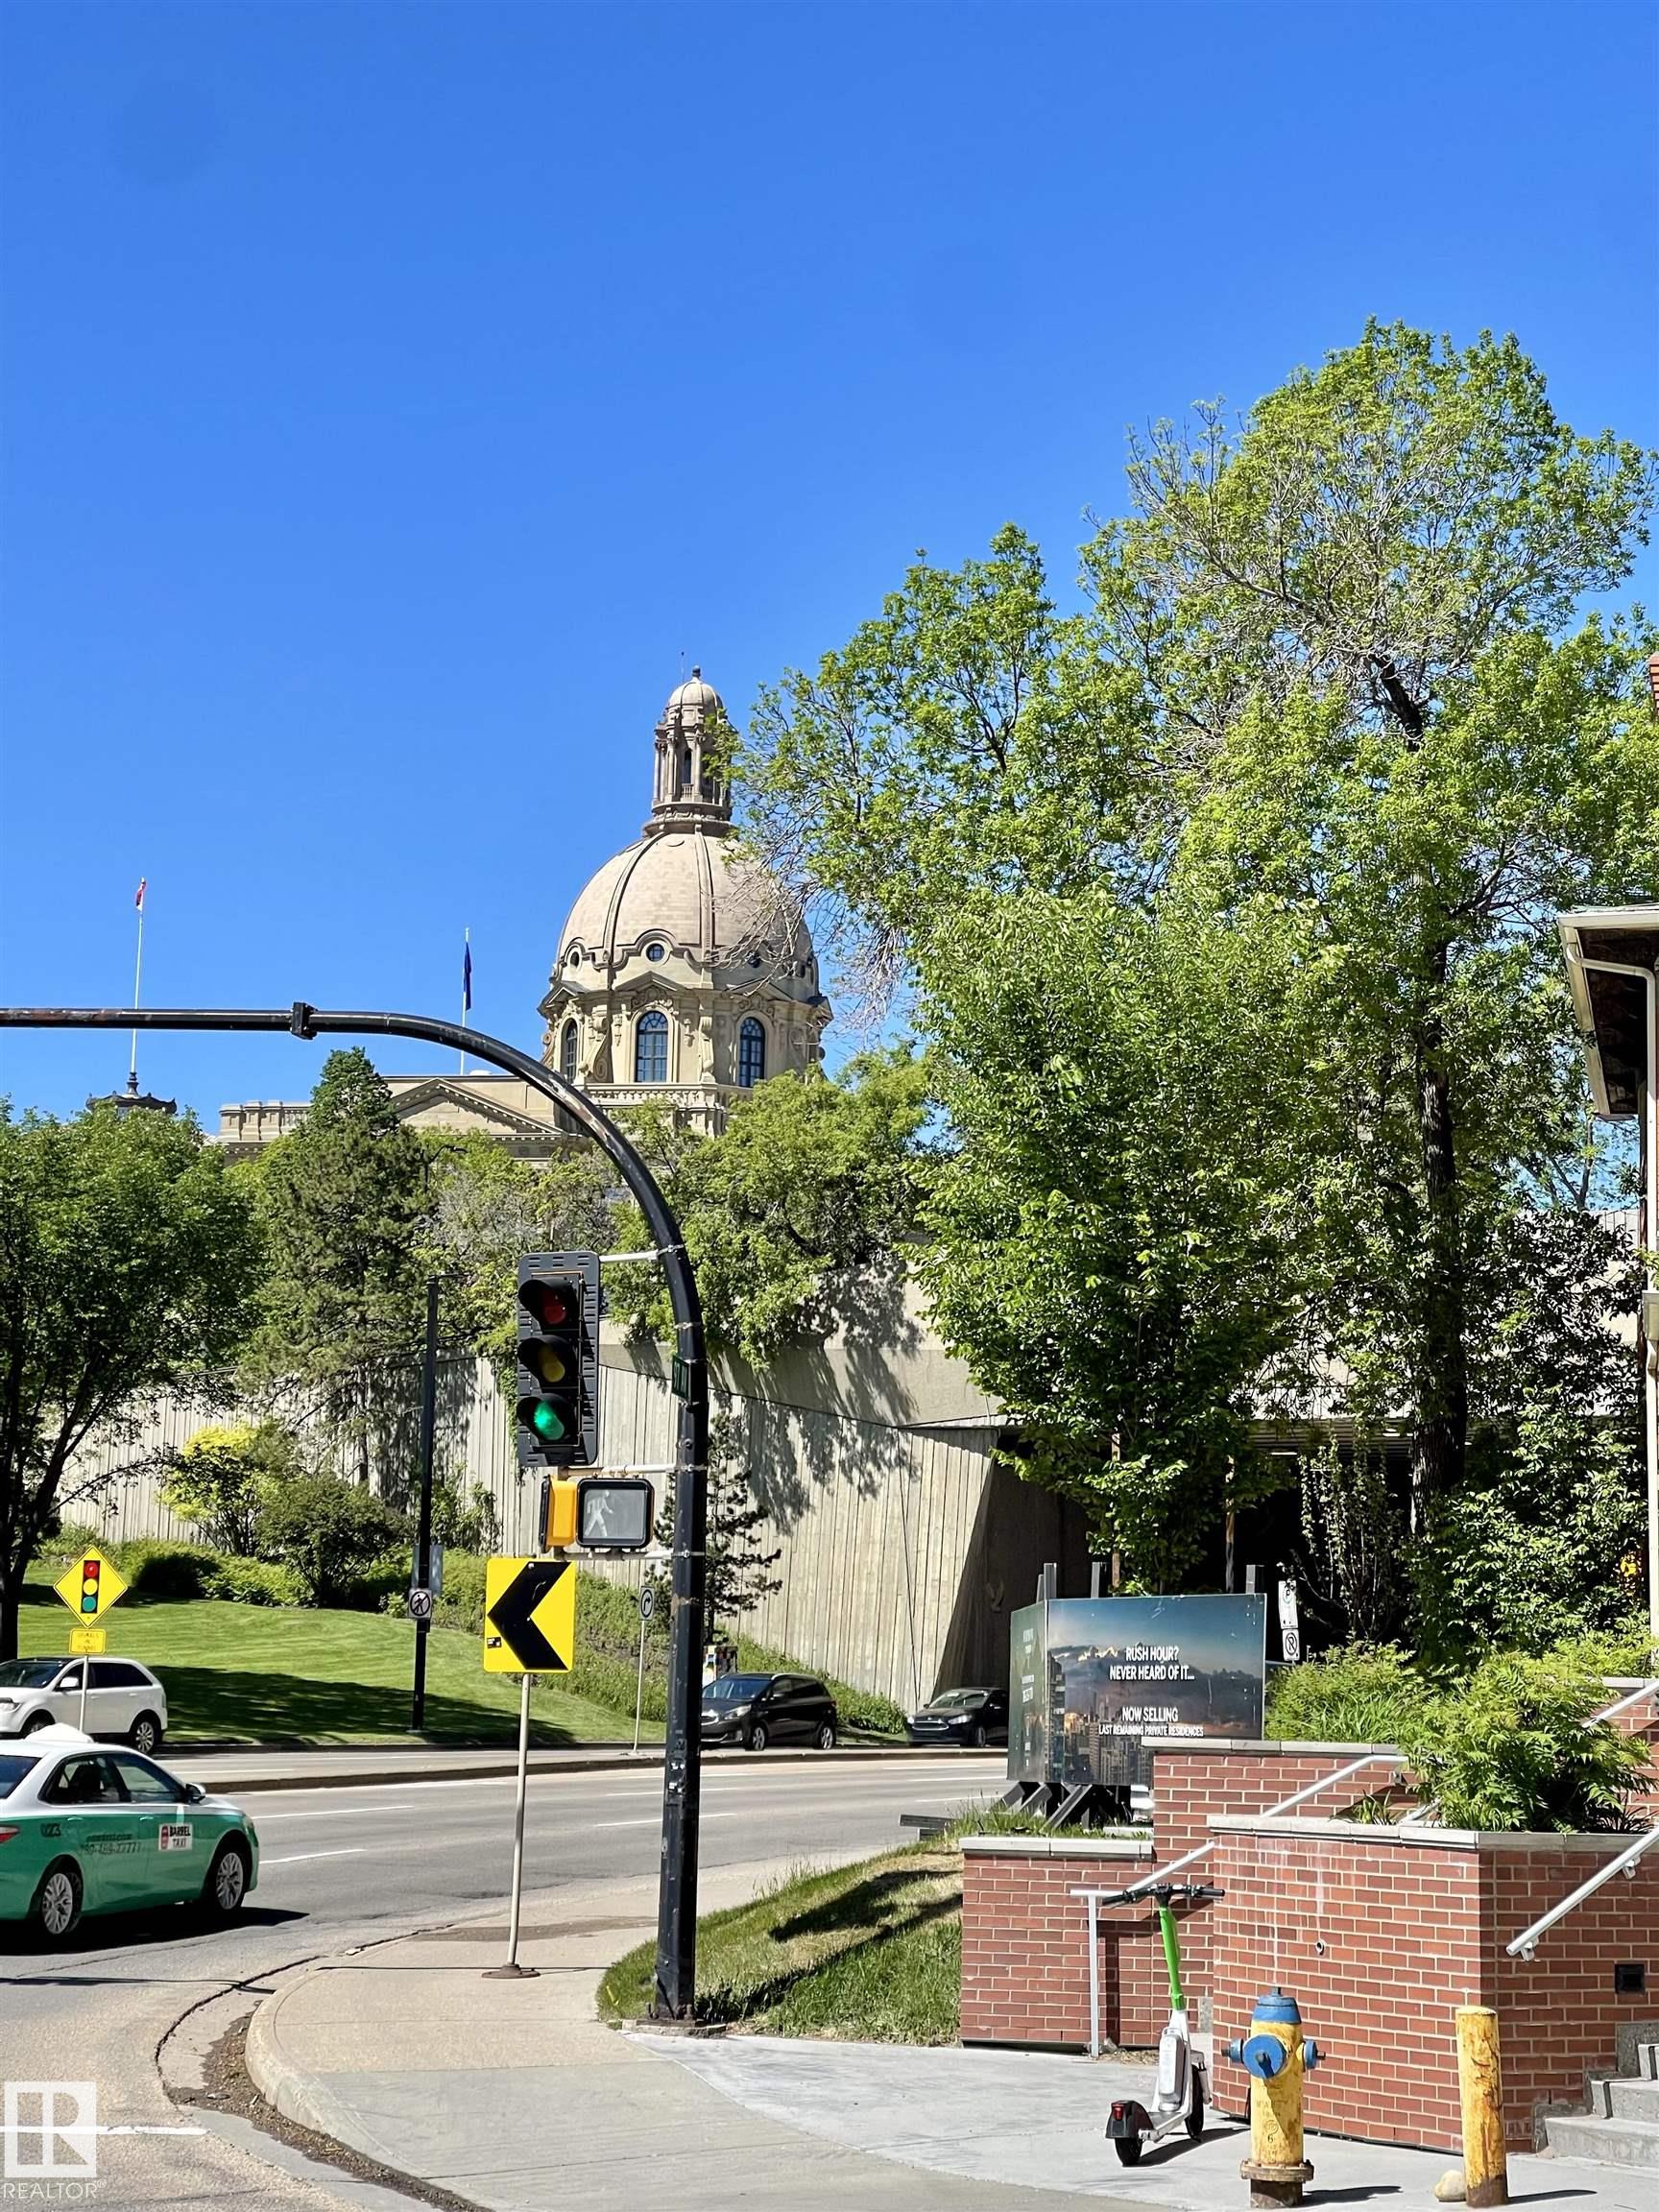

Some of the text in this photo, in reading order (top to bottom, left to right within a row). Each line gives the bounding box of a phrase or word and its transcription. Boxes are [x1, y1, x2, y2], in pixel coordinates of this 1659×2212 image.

[1125, 1646, 1179, 1661] RUSH HOUR?
[1110, 1665, 1137, 1680] NEVER
[1139, 1665, 1166, 1680] HEARD
[1167, 1665, 1179, 1680] OF
[1122, 1706, 1179, 1722] NOW SELLING
[1098, 1724, 1113, 1735] LAST
[1144, 1724, 1168, 1736] PRIVATE
[1168, 1725, 1204, 1737] RESIDENCES
[170, 1826, 191, 1837] BARREL
[173, 1838, 187, 1848] TAXI
